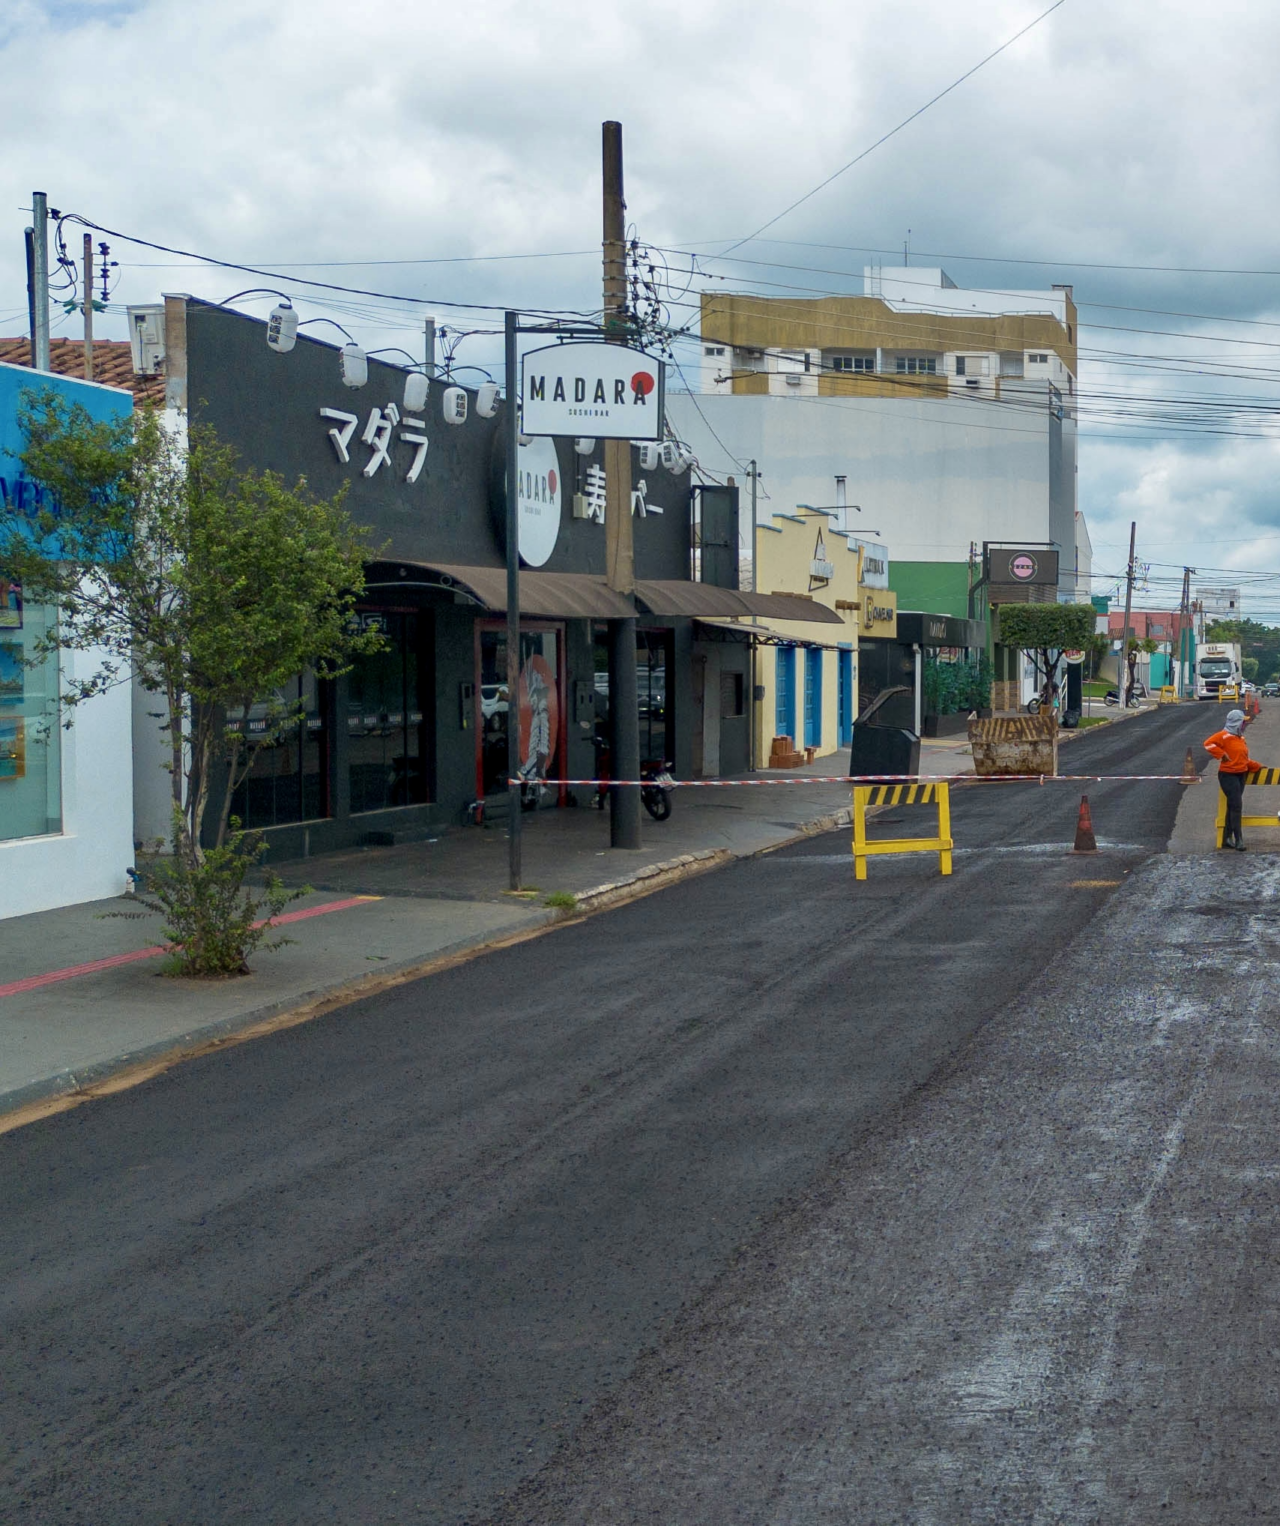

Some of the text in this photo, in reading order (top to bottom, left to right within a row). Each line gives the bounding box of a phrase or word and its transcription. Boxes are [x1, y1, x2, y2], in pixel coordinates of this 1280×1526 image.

[530, 375, 646, 406] MADARA
[568, 408, 609, 417] SUSHI BAR
[319, 403, 430, 483] マダラ
[518, 469, 555, 505] ADARA
